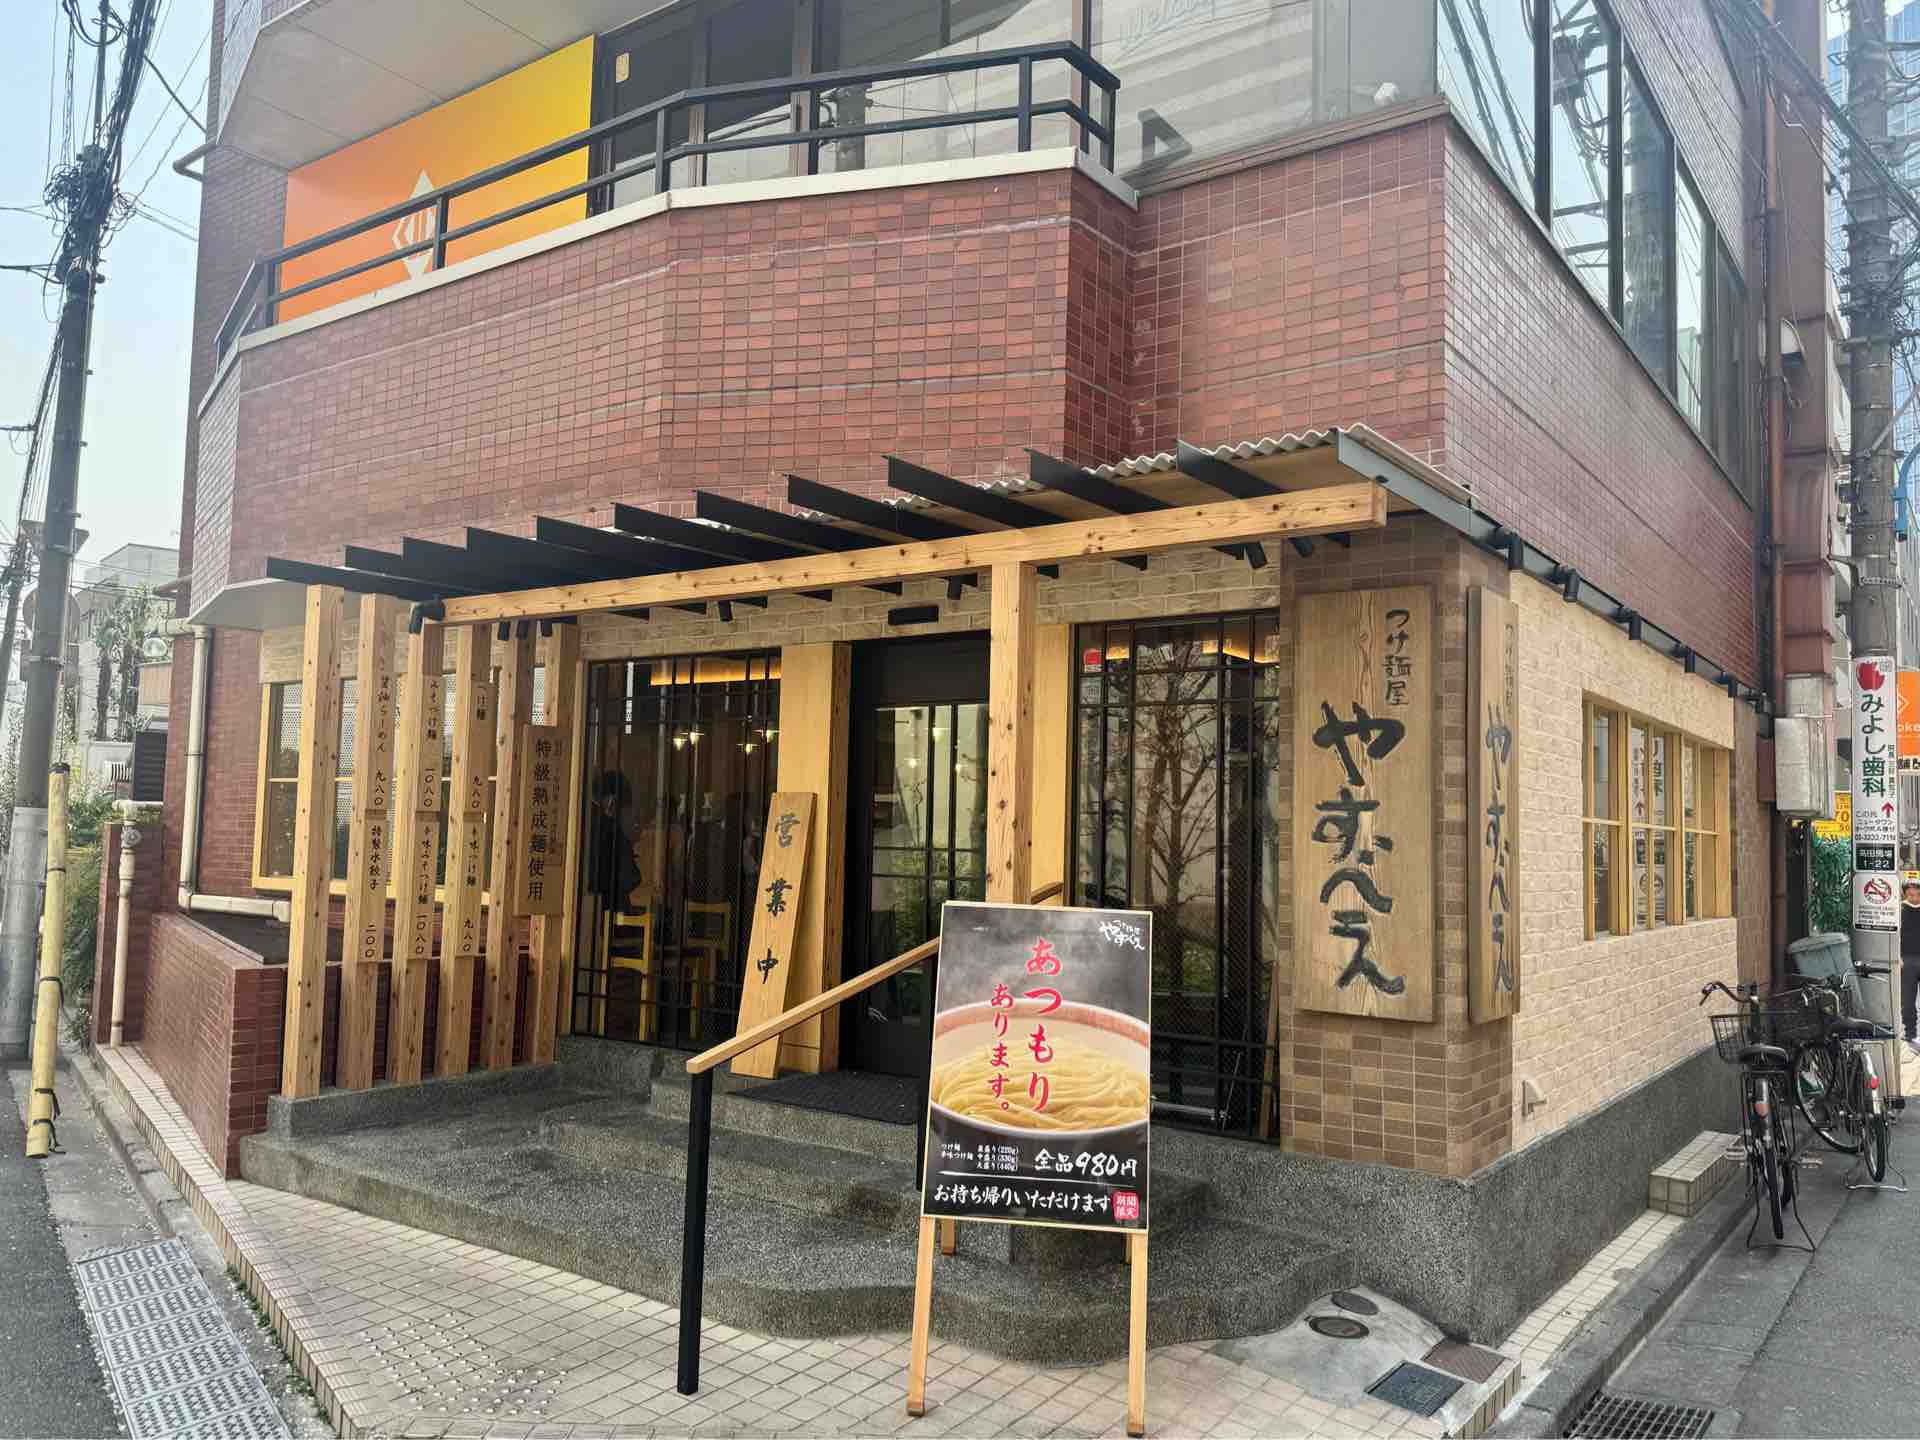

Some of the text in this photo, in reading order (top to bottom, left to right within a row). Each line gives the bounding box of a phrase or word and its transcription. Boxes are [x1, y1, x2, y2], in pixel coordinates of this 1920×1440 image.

[1384, 608, 1413, 706] つけ麺屋
[1860, 693, 1885, 797] みよし歯科
[756, 812, 800, 984] 営業中
[1311, 699, 1406, 996] やすべえ
[987, 983, 1014, 1112] あります。
[1024, 936, 1062, 1112] あつもり
[933, 1183, 1111, 1213] お持ち帰りいただけます
[1034, 1149, 1138, 1178] 全品980円
